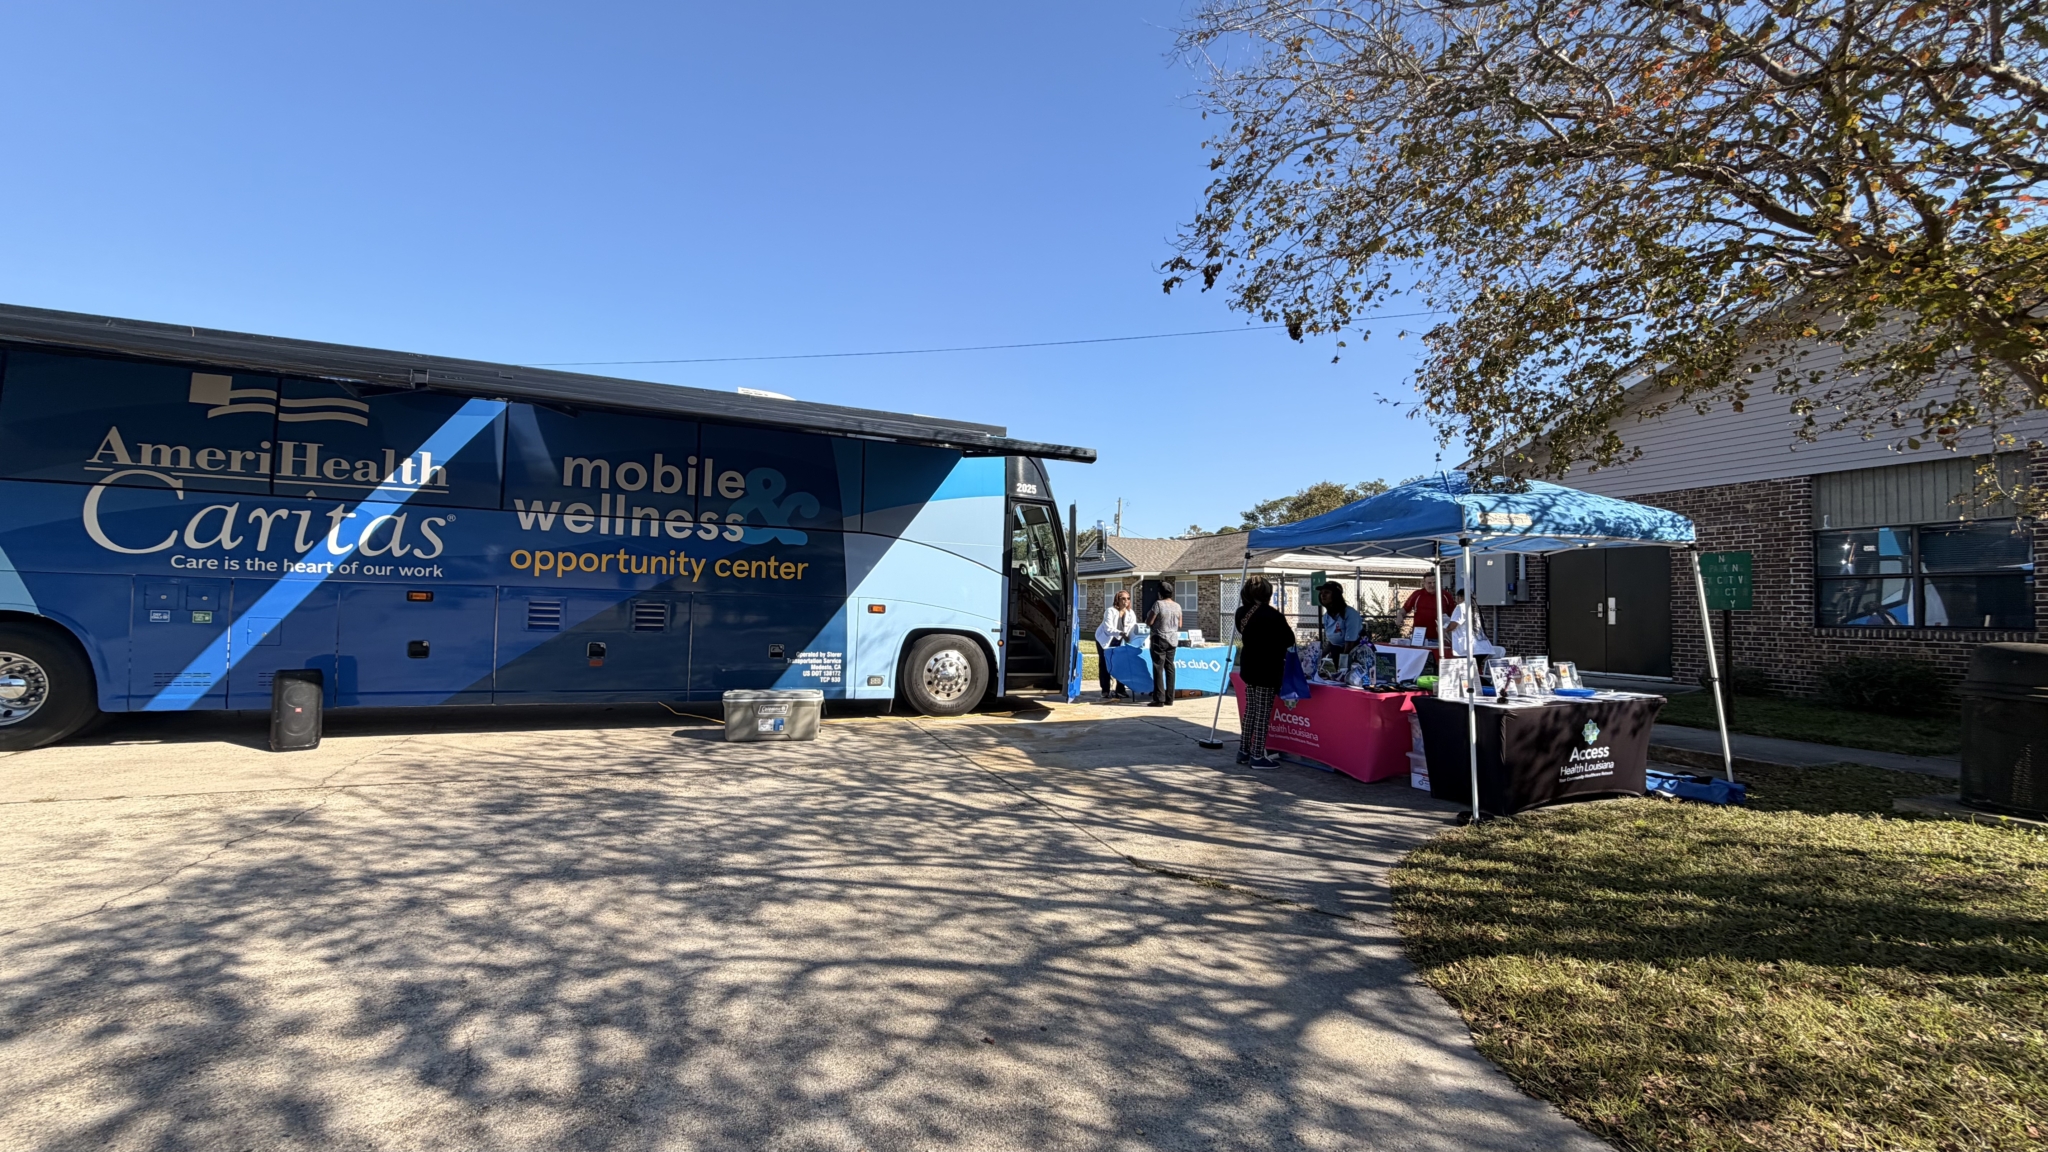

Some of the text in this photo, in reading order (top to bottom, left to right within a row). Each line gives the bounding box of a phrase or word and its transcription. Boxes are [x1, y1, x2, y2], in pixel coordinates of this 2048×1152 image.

[86, 425, 449, 487] AmeriHealth
[562, 453, 746, 499] mobile
[1016, 482, 1037, 495] 2025
[513, 493, 745, 542] wellness
[170, 555, 443, 577] Care is the heart of our work
[510, 548, 809, 582] opportunity center
[1188, 659, 1209, 669] club
[1273, 708, 1311, 728] Access
[1268, 723, 1319, 741] Health Louisiana
[1569, 746, 1610, 762] Access
[1560, 760, 1615, 776] Health Louisiana
